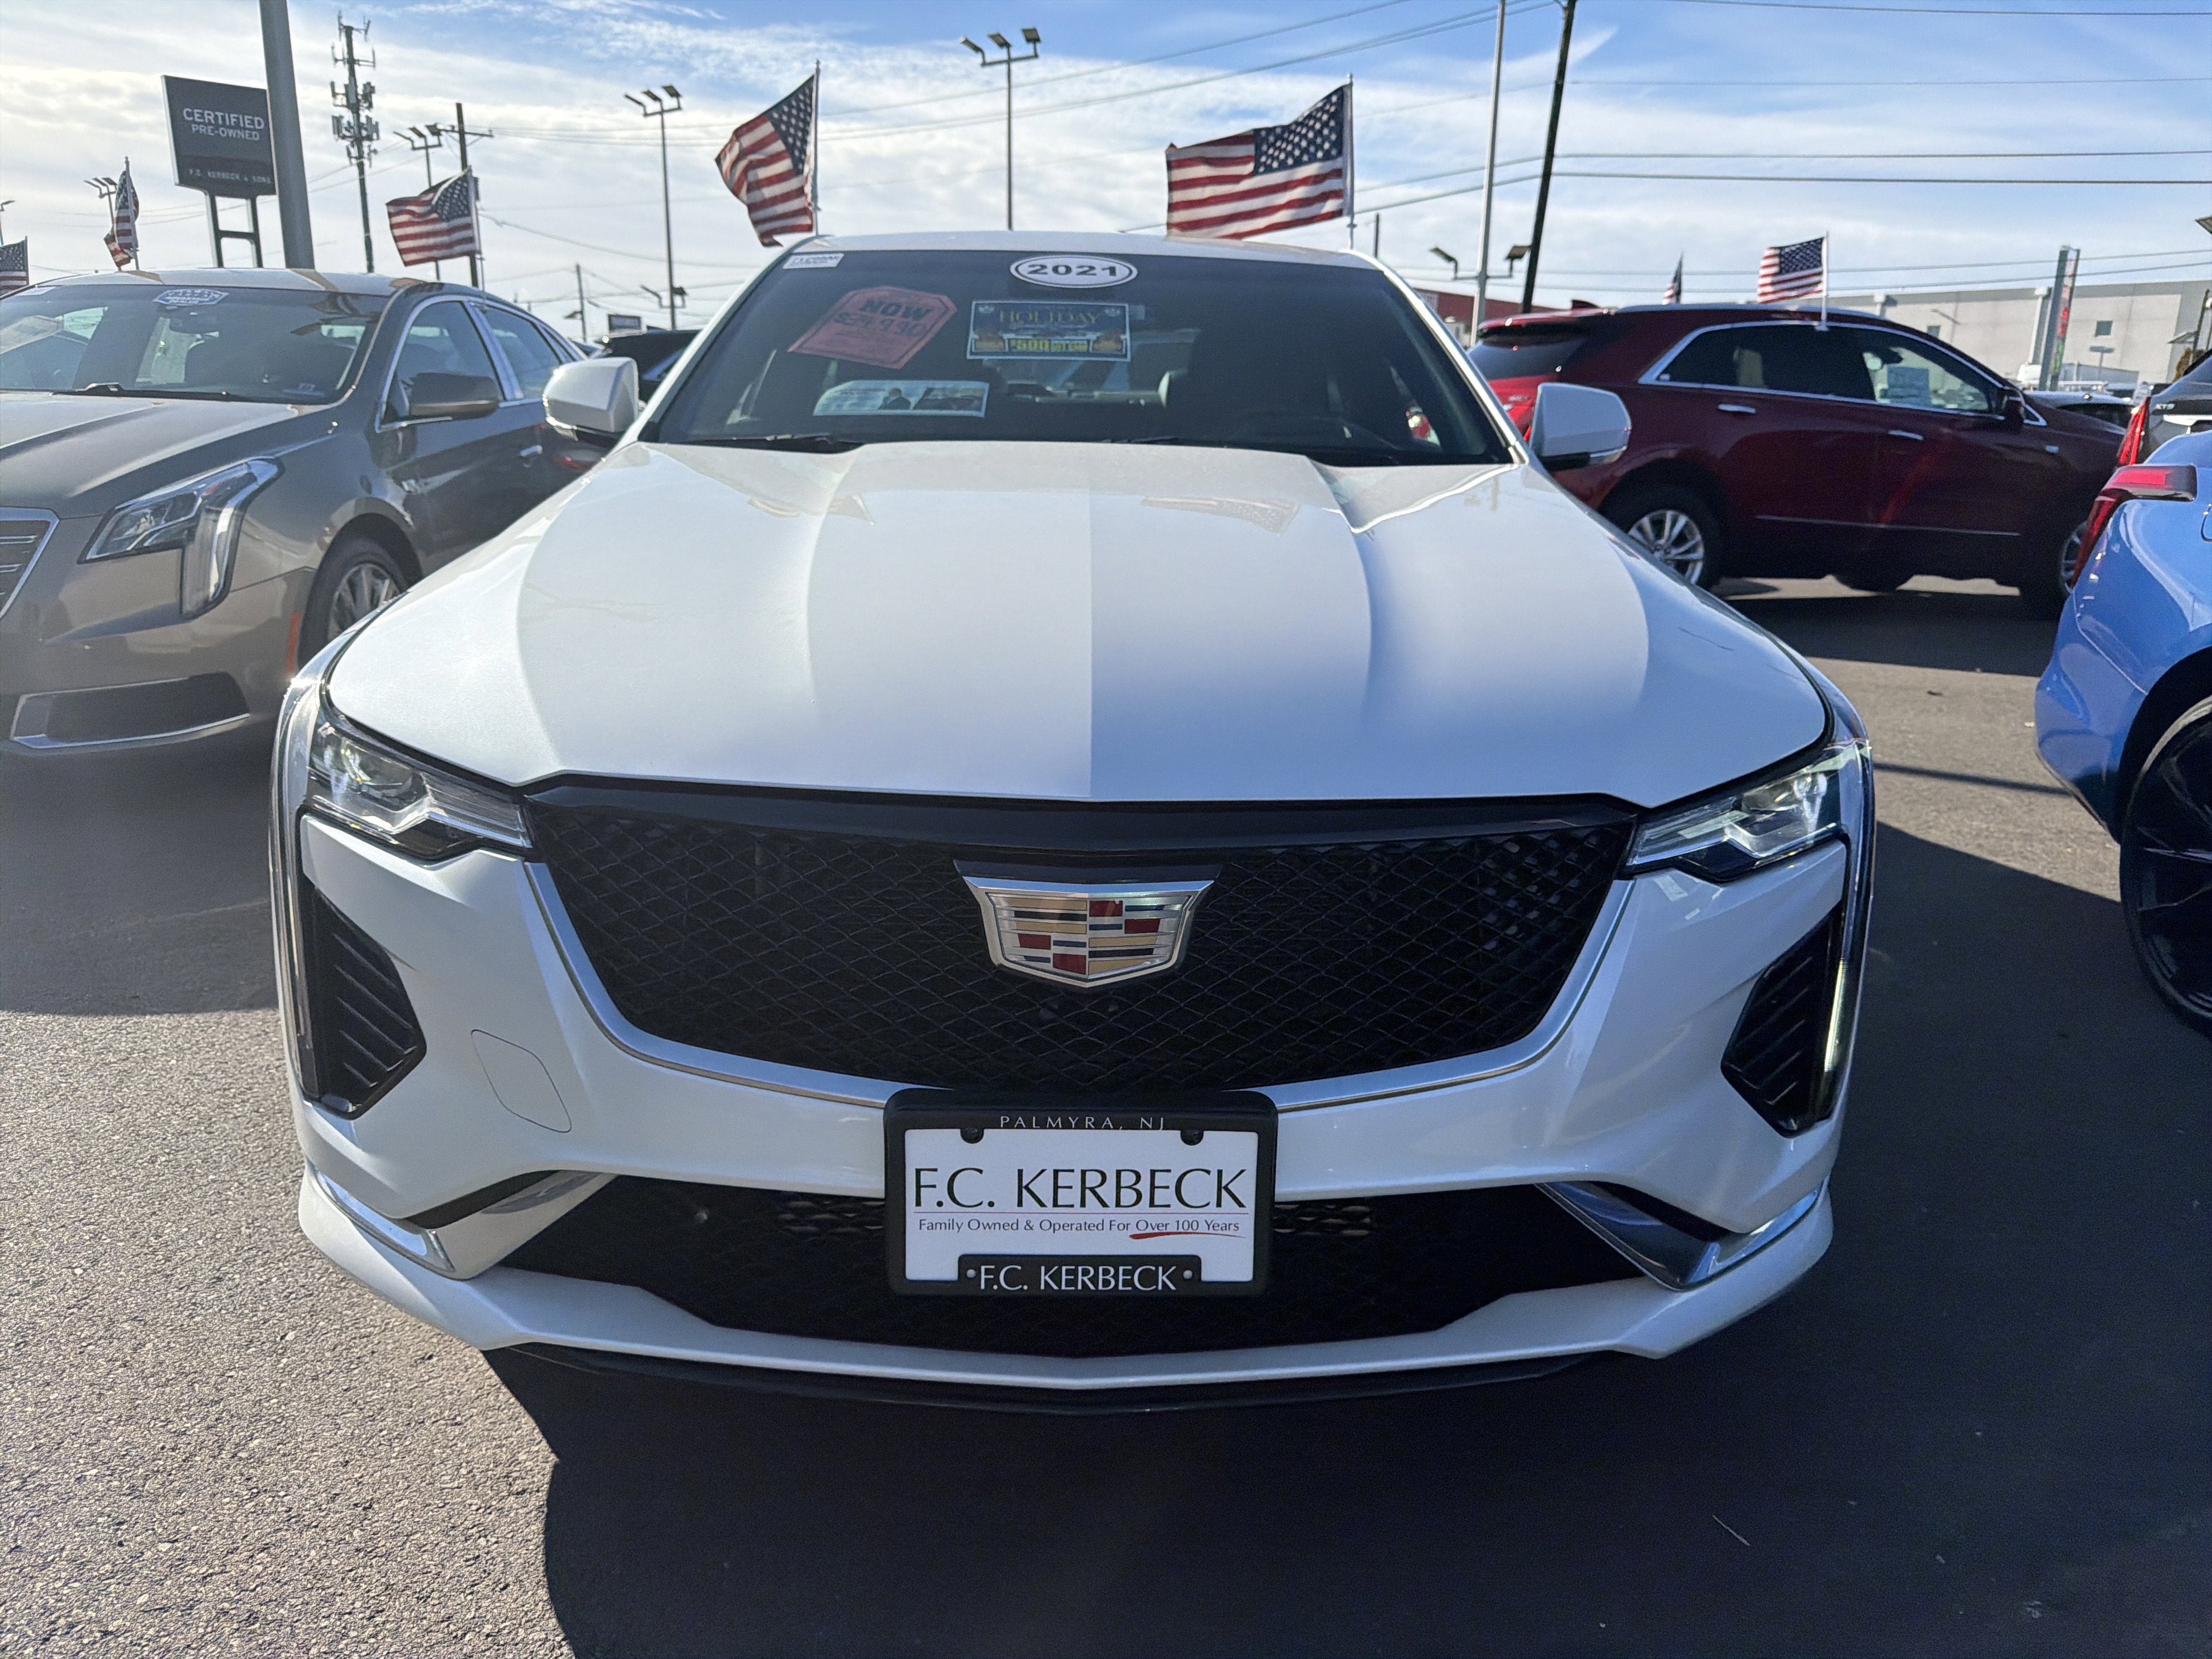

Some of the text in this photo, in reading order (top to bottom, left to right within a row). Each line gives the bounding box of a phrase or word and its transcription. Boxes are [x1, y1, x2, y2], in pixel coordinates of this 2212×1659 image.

[183, 108, 265, 130] CERTIFIED
[192, 123, 260, 141] PRE-OWNED
[1028, 264, 1116, 276] 2021
[859, 300, 934, 321] NOW
[1000, 1116, 1164, 1131] PALMYRA, NJ
[915, 1167, 1247, 1209] F.C. KERBECK
[919, 1218, 1240, 1234] Family Owned & Operated For Over 100 Years
[980, 1265, 1177, 1291] F.C. KERBECK
